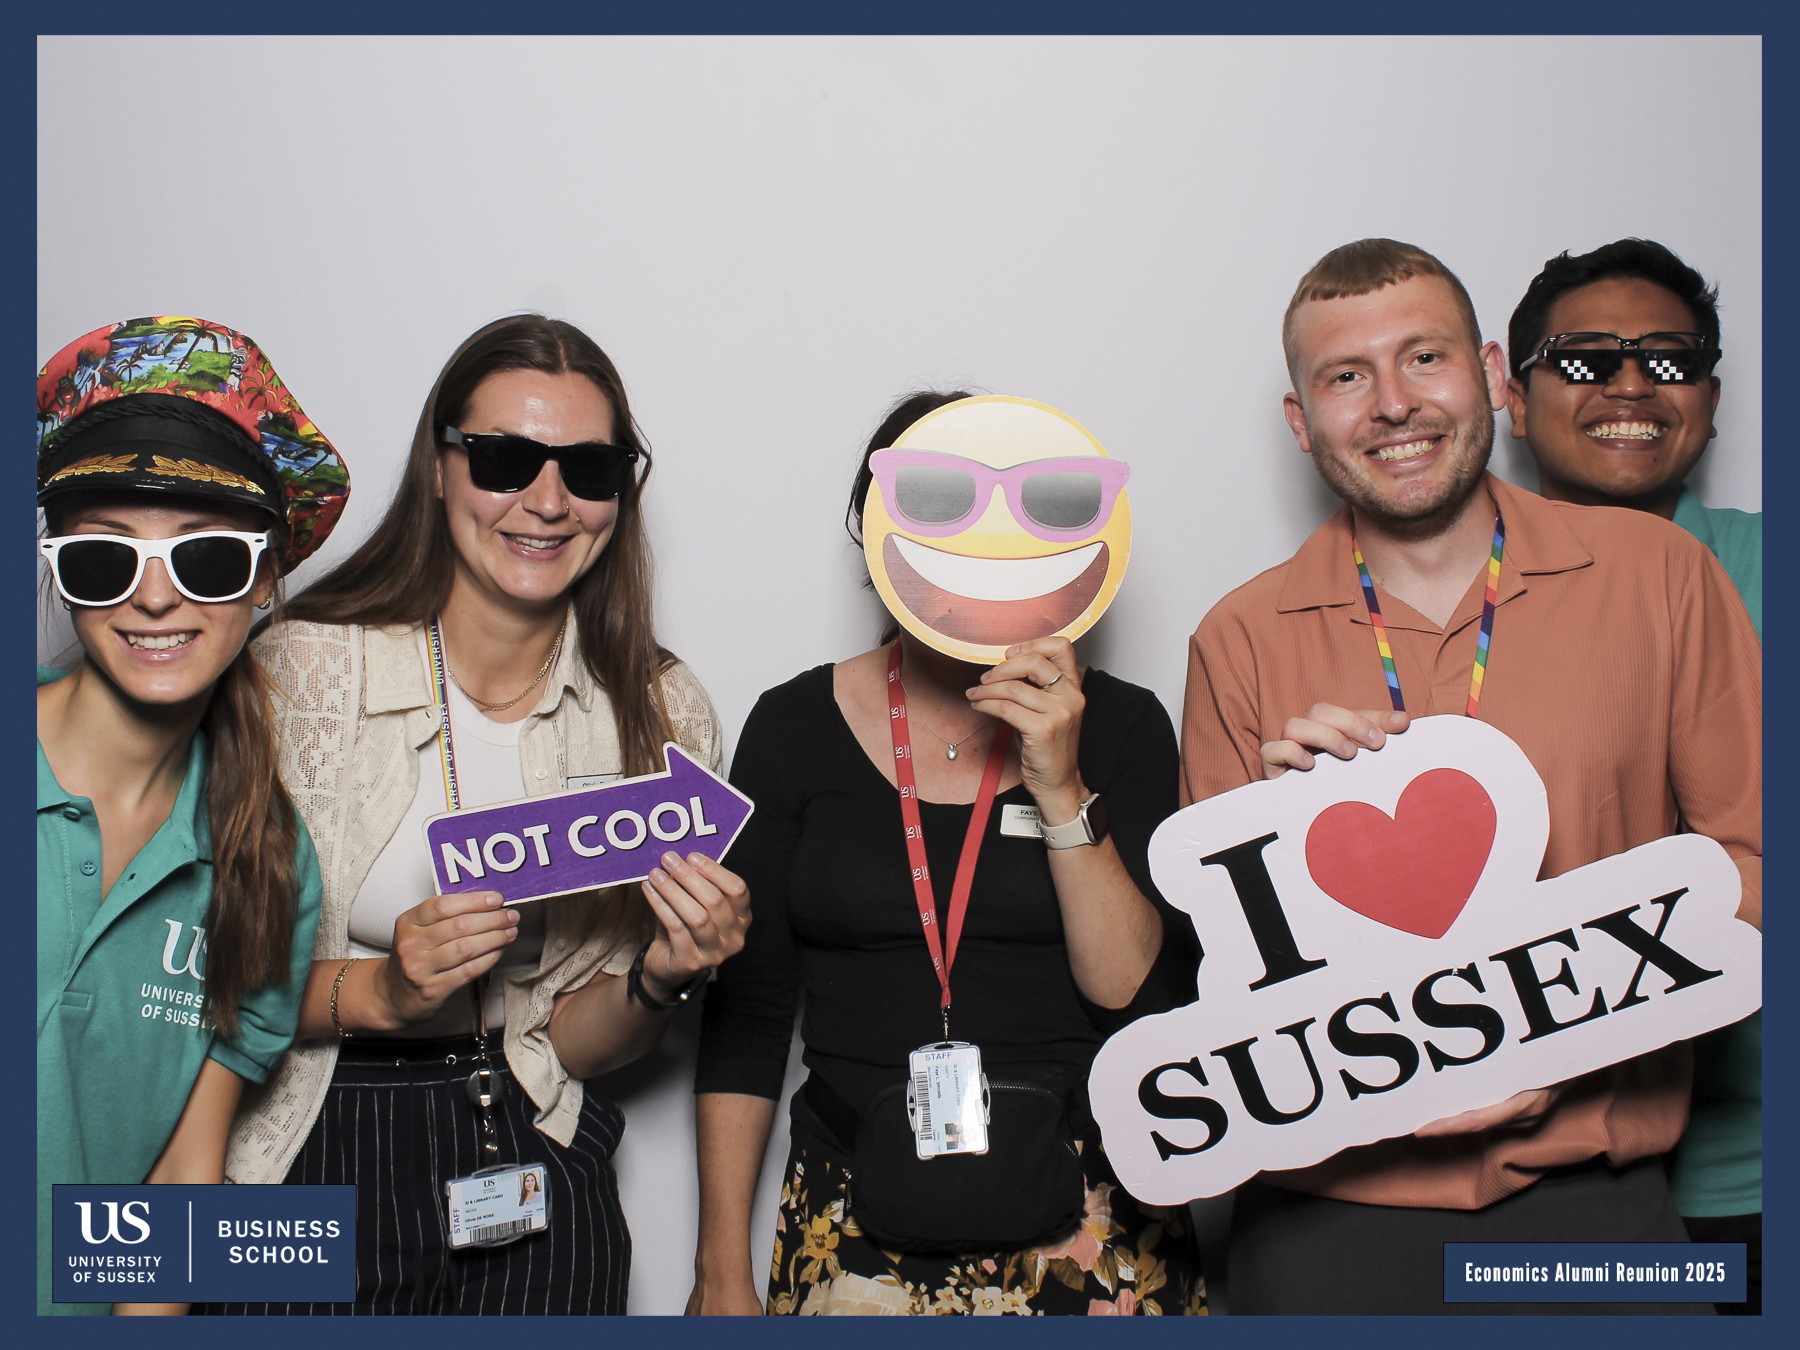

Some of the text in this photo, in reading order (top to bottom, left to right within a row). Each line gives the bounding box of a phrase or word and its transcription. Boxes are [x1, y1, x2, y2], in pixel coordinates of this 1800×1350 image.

[430, 625, 445, 685] UNIVERSITY
[891, 707, 900, 719] US
[439, 703, 460, 810] VERSITY OF SUSSEX
[895, 746, 904, 759] US
[901, 786, 910, 798] US
[906, 826, 915, 839] US
[440, 796, 718, 884] NOT COOL
[912, 868, 922, 881] US
[1200, 831, 1327, 991] I
[922, 912, 930, 926] US
[141, 983, 206, 1009] UNIVERS
[141, 1004, 217, 1030] OF SUSS
[1137, 887, 1724, 1162] SUSSEX
[926, 1052, 952, 1061] STAFF
[483, 1179, 495, 1188] US
